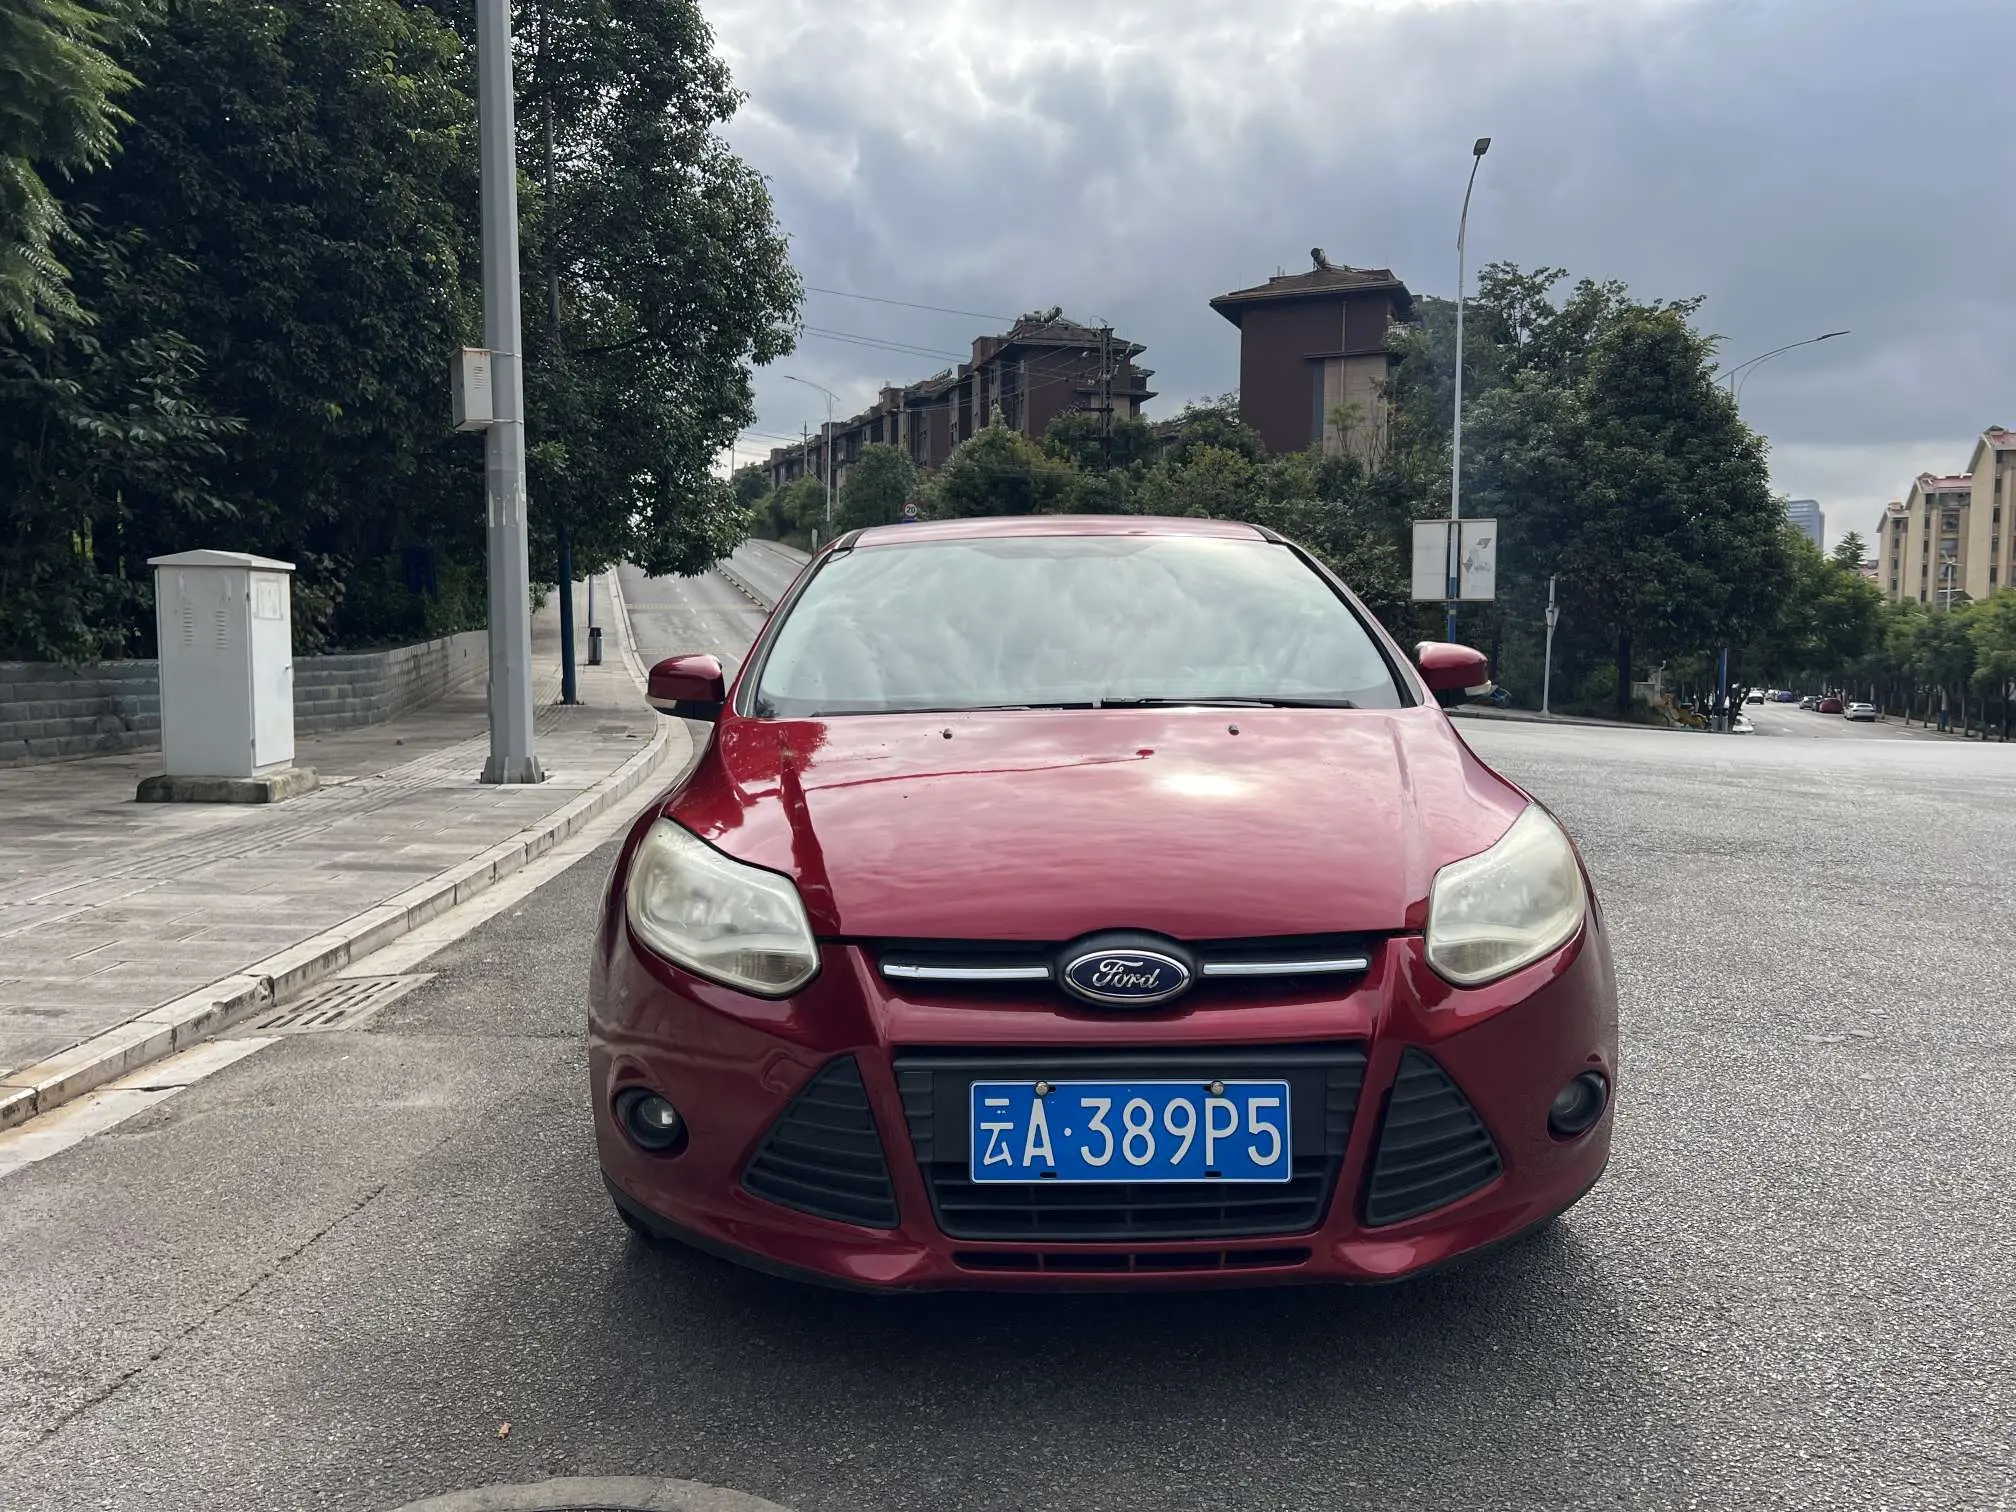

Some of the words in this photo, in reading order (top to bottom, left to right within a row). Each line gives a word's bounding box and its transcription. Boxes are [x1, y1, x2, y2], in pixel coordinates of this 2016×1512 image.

[906, 505, 916, 514] 20
[1092, 959, 1161, 989] Ford
[980, 1097, 1281, 1166] 云A·389P5
